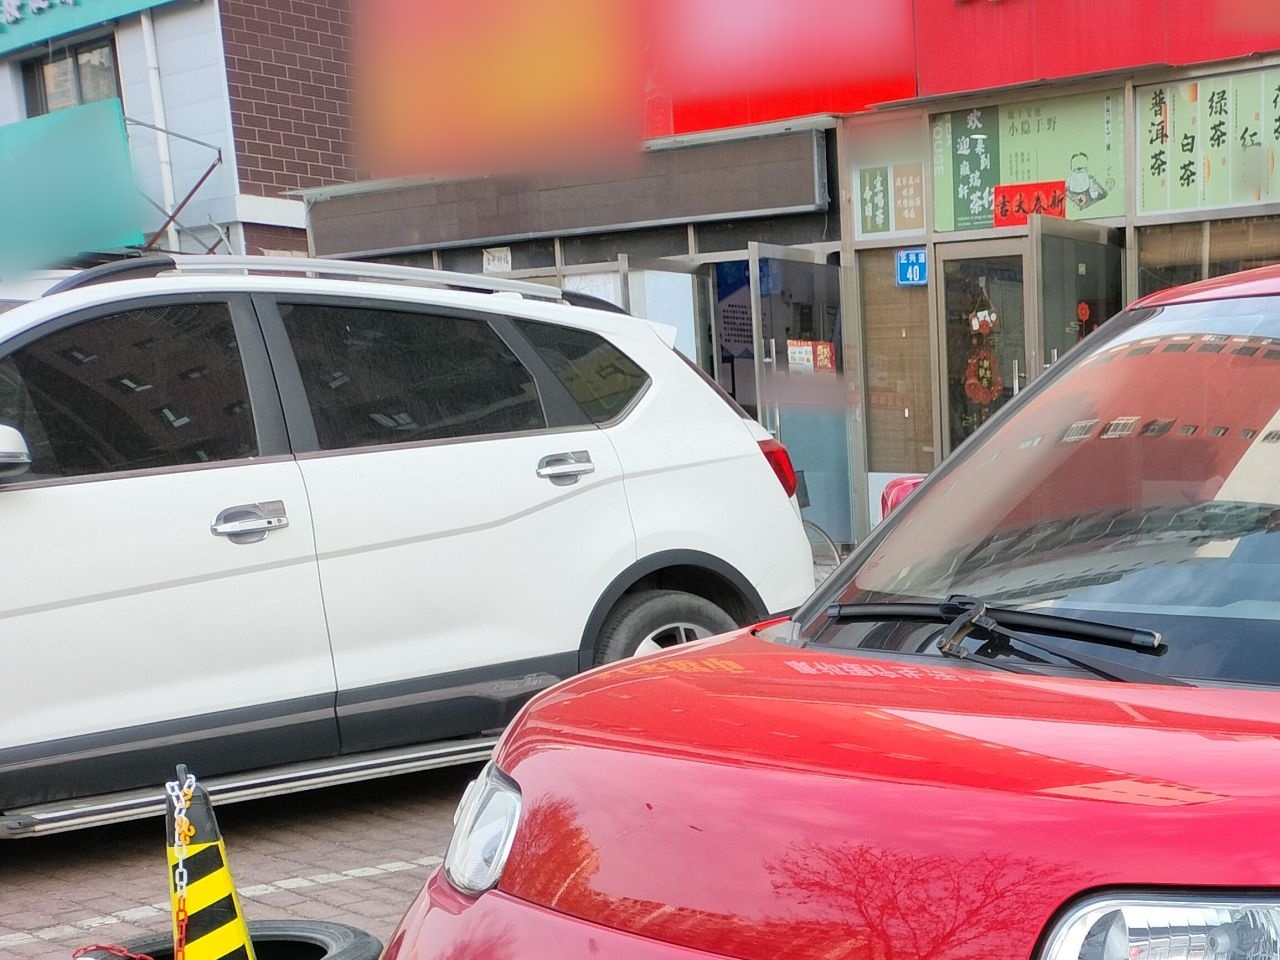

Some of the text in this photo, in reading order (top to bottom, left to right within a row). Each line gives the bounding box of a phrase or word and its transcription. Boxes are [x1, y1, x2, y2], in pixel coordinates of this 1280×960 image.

[1149, 89, 1169, 177] 普洱茶
[1208, 89, 1228, 148] 绿茶
[1179, 133, 1197, 188] 白茶
[906, 265, 920, 281] 40
